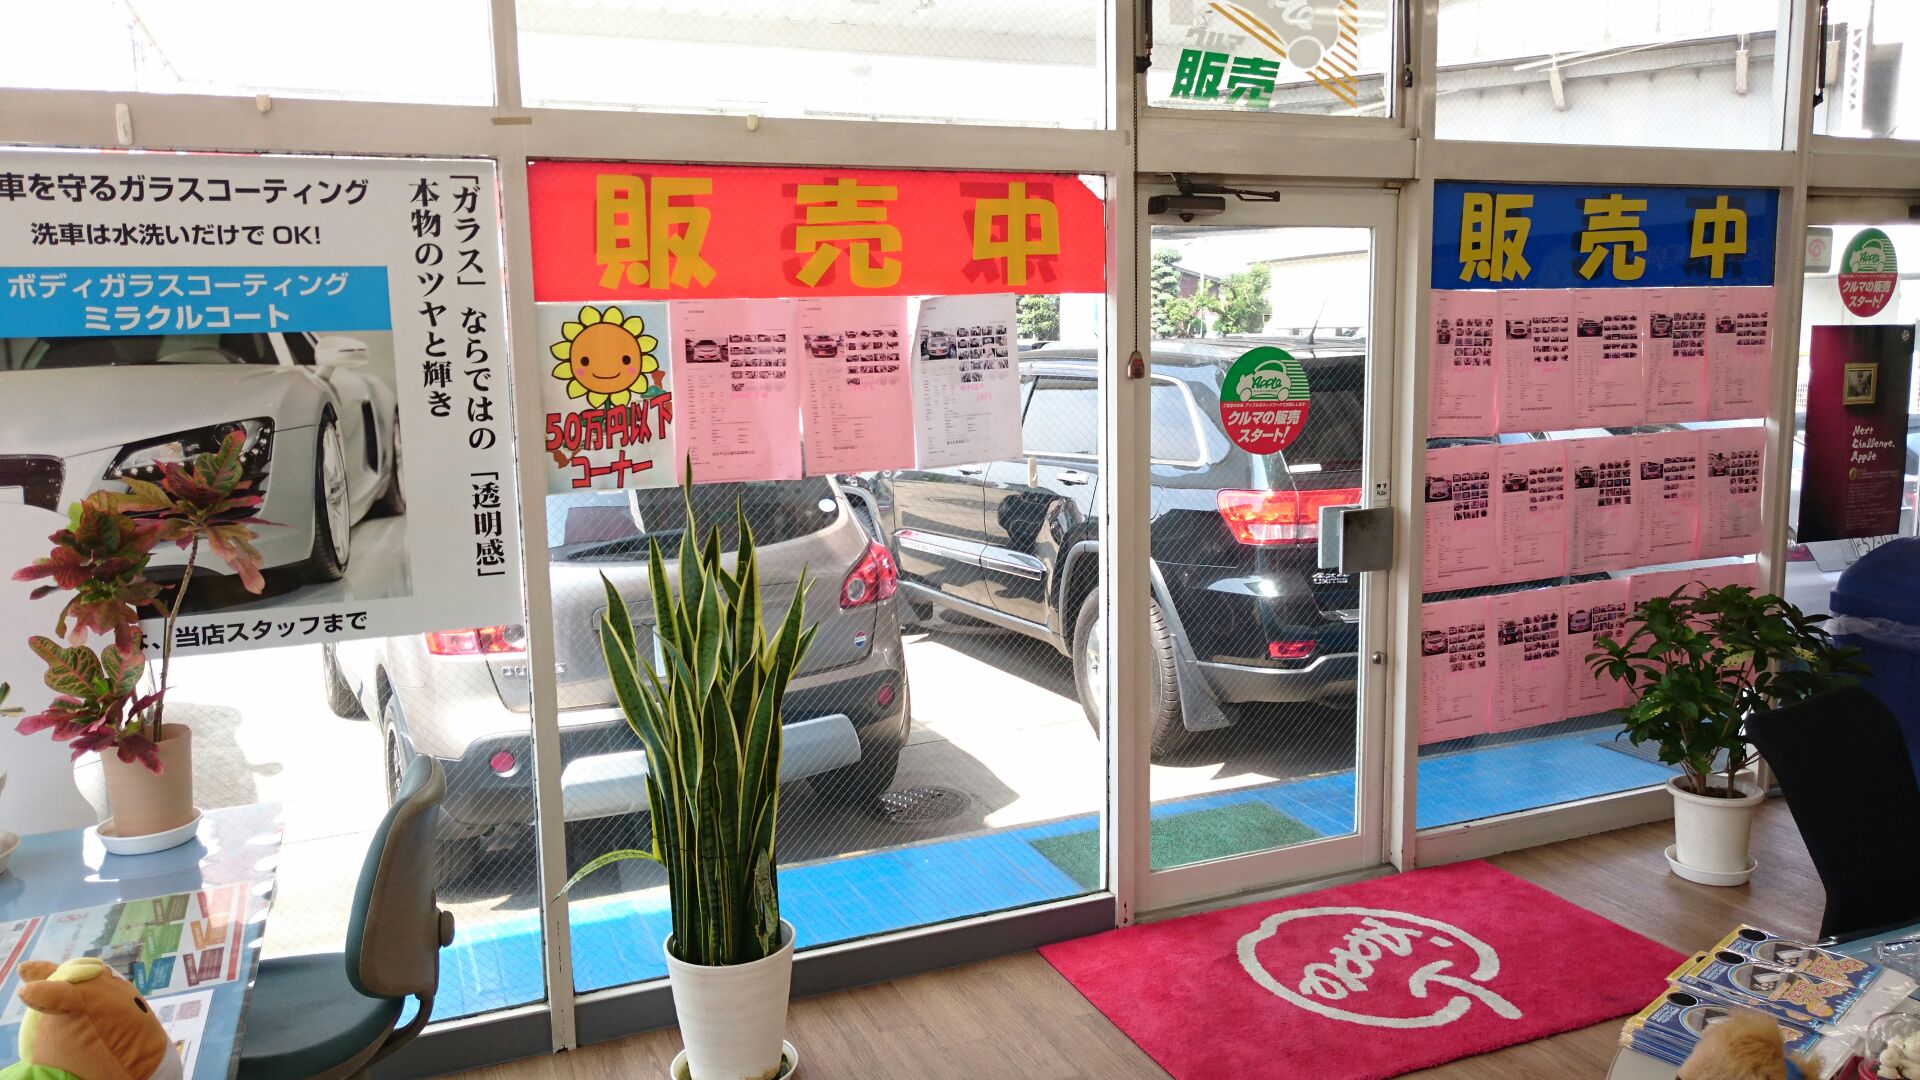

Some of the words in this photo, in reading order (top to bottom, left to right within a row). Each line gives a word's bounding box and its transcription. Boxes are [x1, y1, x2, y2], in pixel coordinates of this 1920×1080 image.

[1169, 48, 1281, 108] 販売
[0, 173, 369, 205] 車を守るガラスコーティング
[30, 222, 264, 247] 洗車は水洗いだけで
[273, 225, 321, 245] OK!
[595, 173, 1061, 290] 販売中
[1459, 192, 1747, 282] 販売中
[8, 271, 349, 300] ボディガラスコーティング
[408, 177, 454, 418] 本物のツヤと輝き
[1842, 280, 1892, 293] クルマの販売
[1848, 294, 1884, 309] スタート!
[84, 303, 290, 332] ミラクルコート
[545, 391, 672, 451] 50万円以下
[1227, 410, 1302, 426] クルマの販売
[1852, 425, 1874, 437] Next
[1238, 425, 1291, 444] スタート!
[571, 450, 653, 489] コーナー
[1850, 450, 1877, 464] Apple
